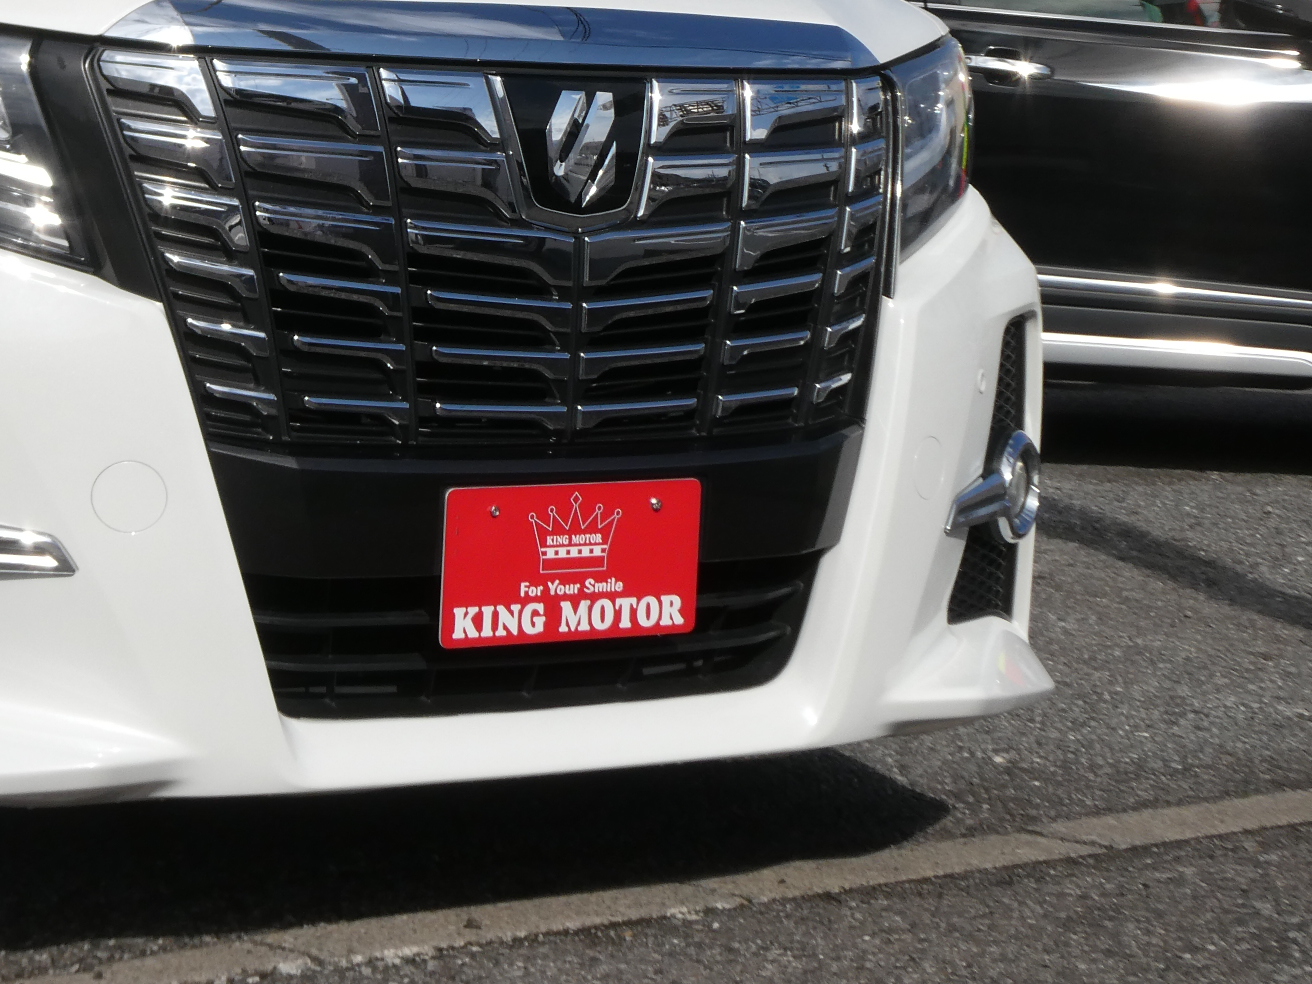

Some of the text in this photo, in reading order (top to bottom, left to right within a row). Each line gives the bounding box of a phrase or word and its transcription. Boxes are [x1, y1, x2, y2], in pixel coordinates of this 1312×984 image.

[546, 533, 603, 546] KING MOTOR
[520, 577, 623, 598] For Your Smile
[452, 594, 685, 640] KING MOTOR
